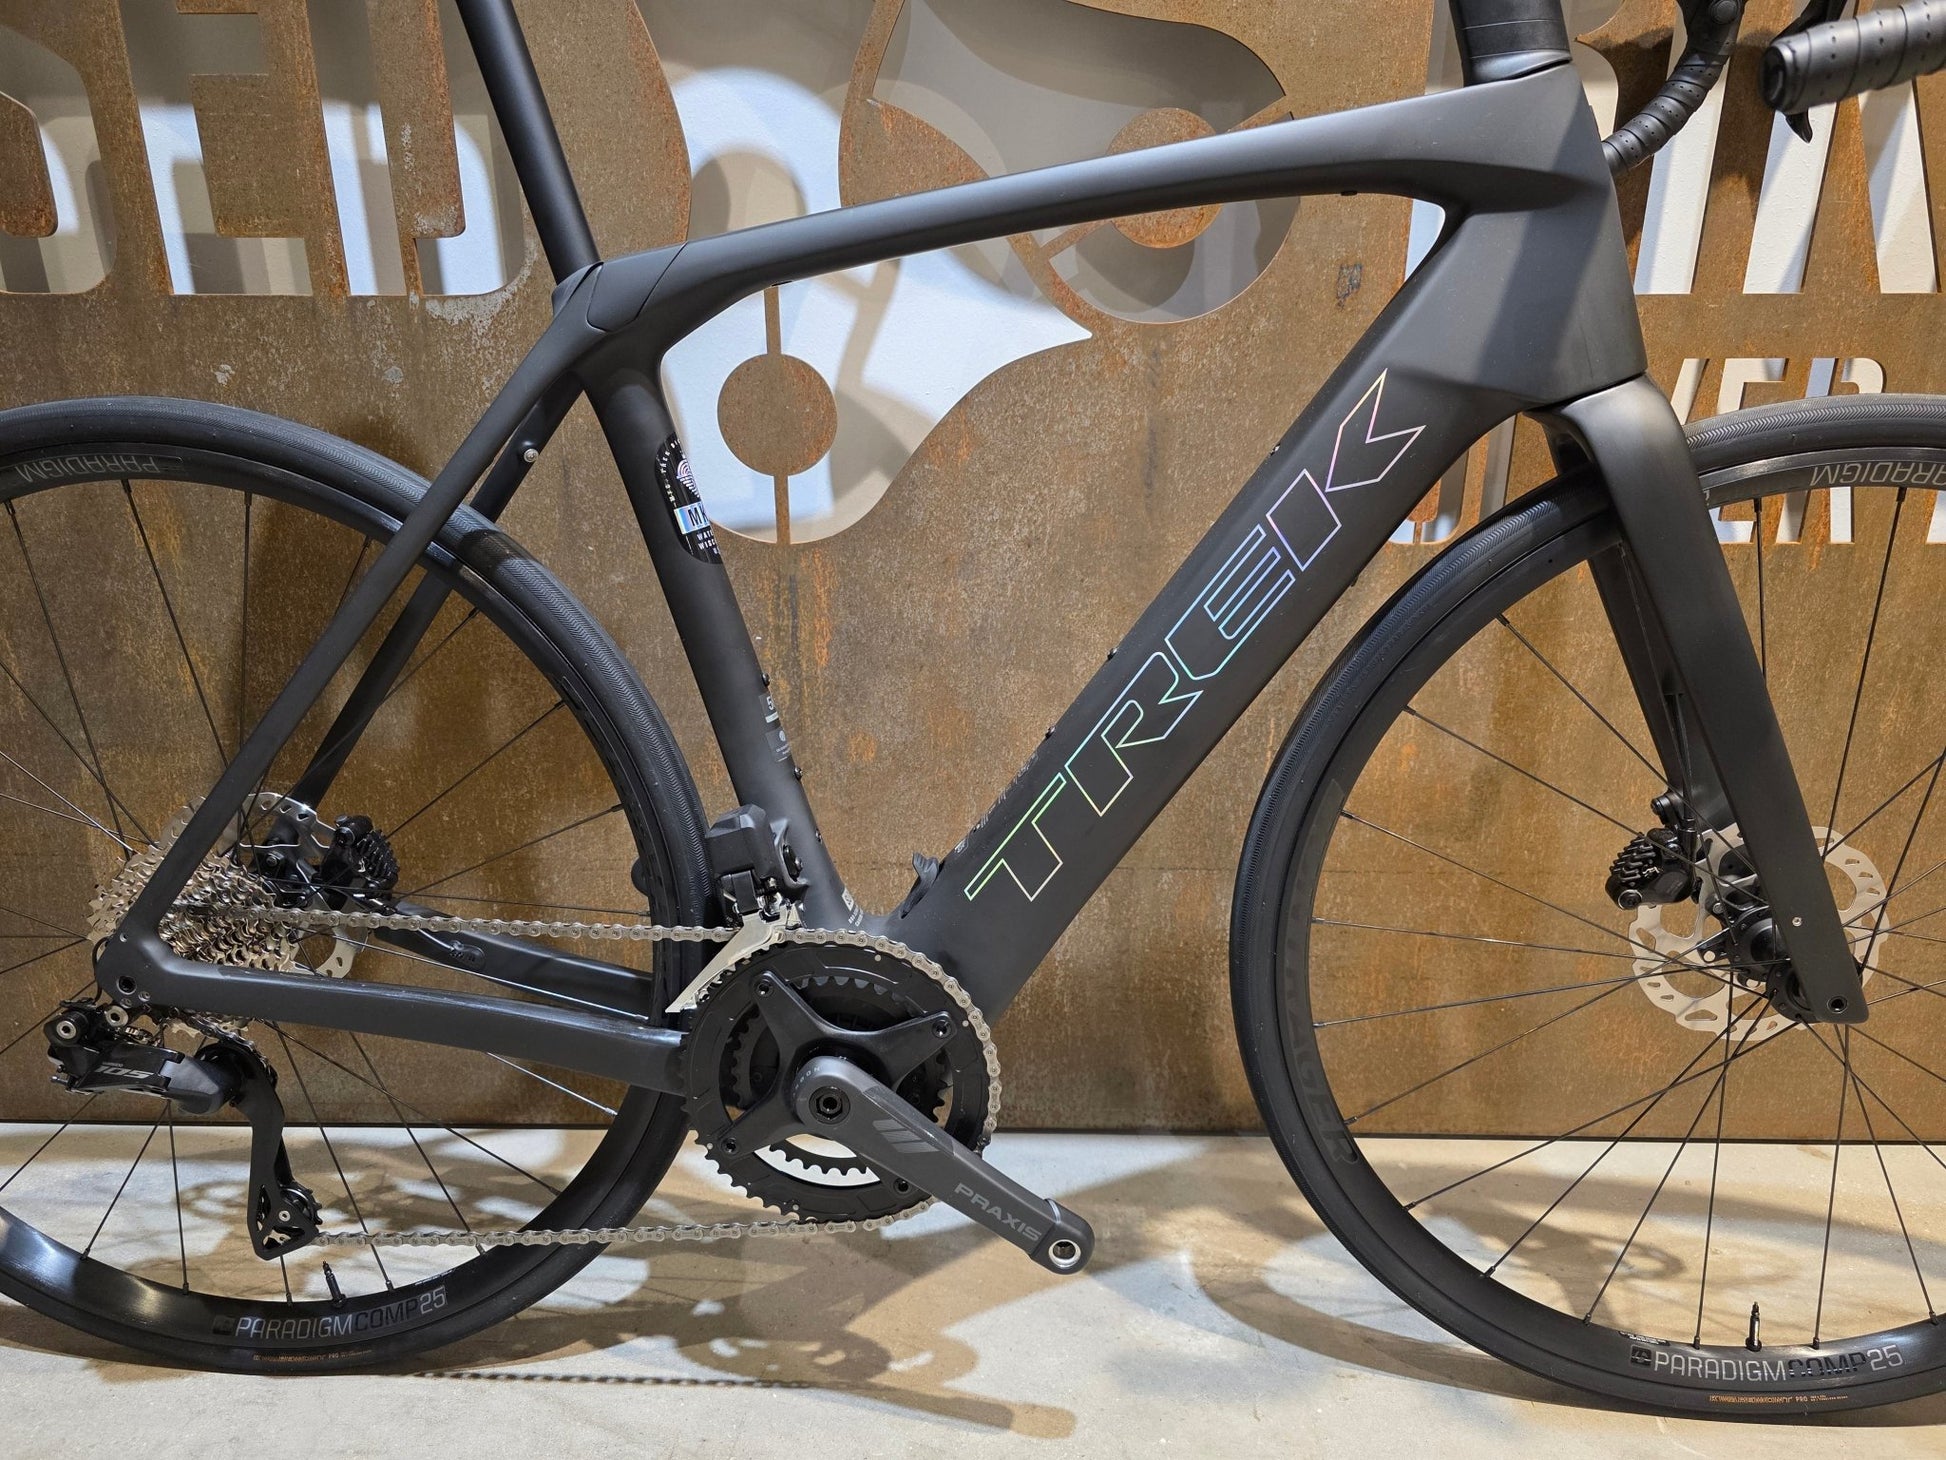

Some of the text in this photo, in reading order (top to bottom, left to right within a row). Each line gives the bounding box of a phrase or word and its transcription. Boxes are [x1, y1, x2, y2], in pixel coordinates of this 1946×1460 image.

[14, 455, 161, 483] PARADIGM
[964, 368, 1427, 902] TREK
[94, 1065, 155, 1079] 105
[953, 1182, 1042, 1242] PRAXIS
